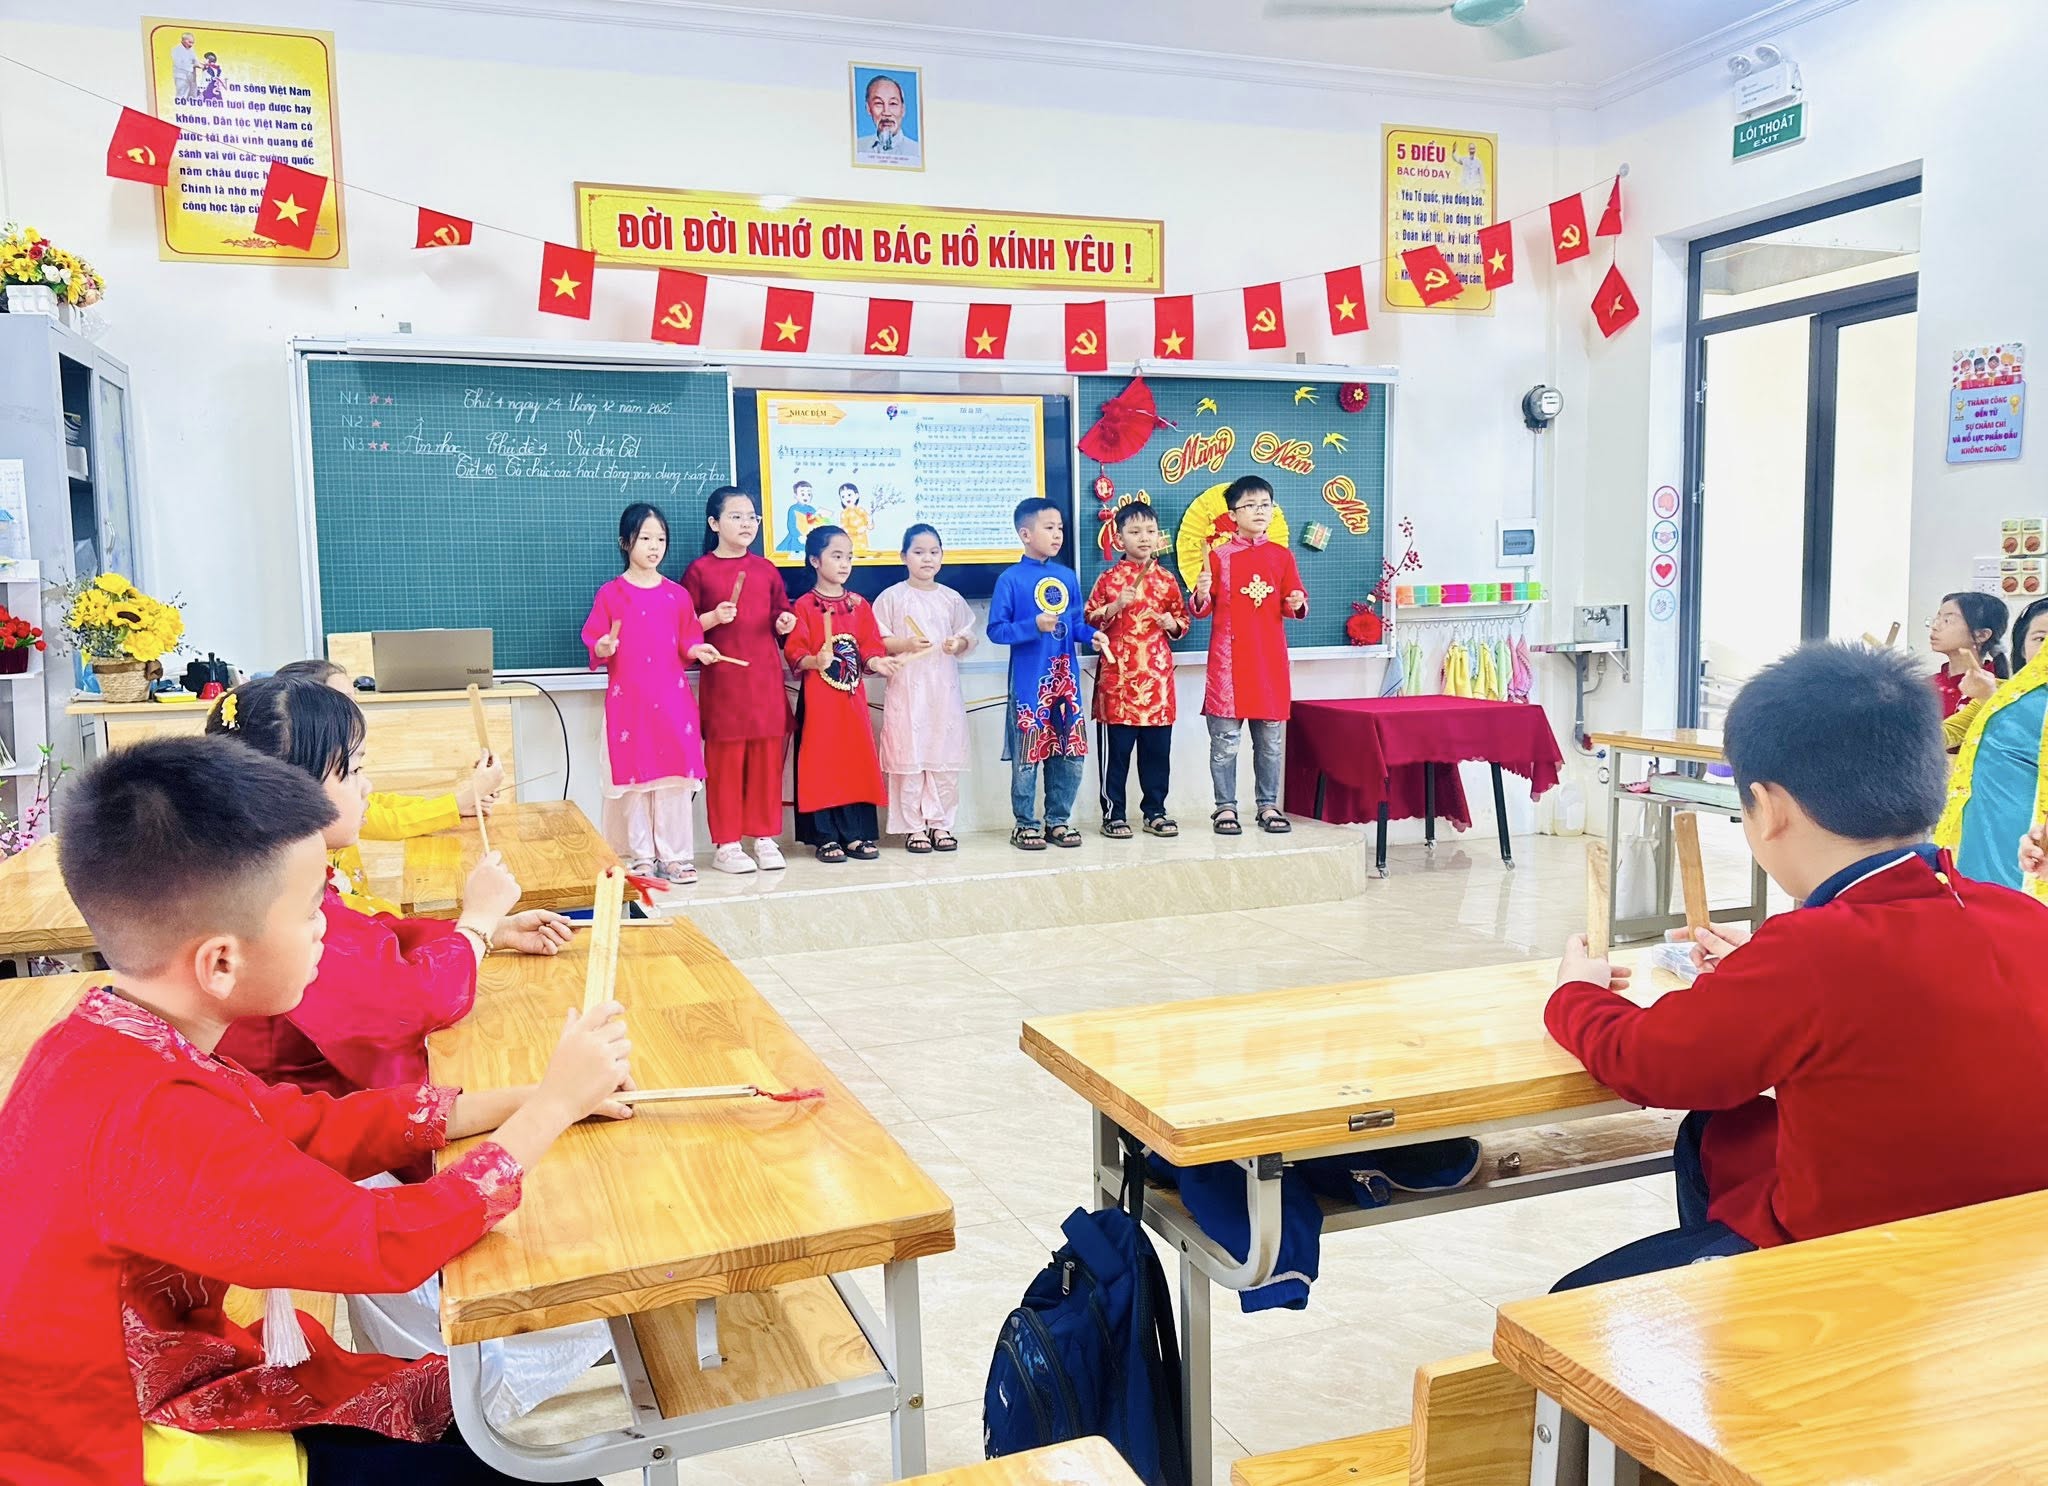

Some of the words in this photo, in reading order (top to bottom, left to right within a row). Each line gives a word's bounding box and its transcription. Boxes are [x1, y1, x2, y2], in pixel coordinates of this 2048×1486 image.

[244, 83, 266, 95] sông
[269, 85, 287, 97] Việt
[289, 87, 311, 97] Nam
[248, 101, 266, 112] đẹp
[269, 102, 292, 114] được
[294, 104, 312, 115] hay
[213, 115, 233, 126] Dân
[235, 117, 251, 128] tộc
[254, 118, 273, 130] Việt
[275, 120, 298, 130] Nam
[1758, 113, 1795, 136] THOÁT
[267, 137, 298, 148] quang
[1753, 133, 1780, 148] EXIT
[204, 151, 219, 160] vai
[291, 154, 315, 165] quốc
[1397, 143, 1406, 160] 5
[205, 168, 231, 178] châu
[215, 184, 225, 194] là
[182, 201, 207, 212] công
[209, 202, 228, 214] học
[230, 203, 246, 214] tập
[248, 203, 261, 214] củ
[1443, 212, 1453, 224] lao
[616, 207, 674, 252] ĐỜI
[683, 210, 738, 255] ĐỜI
[746, 217, 813, 260] NHỚ
[821, 221, 864, 263] ƠN
[872, 224, 932, 266] BÁC
[940, 225, 980, 269] HỒ
[988, 229, 1056, 272] KÍNH
[1063, 235, 1115, 274] YÊU
[1124, 243, 1132, 275] !
[1990, 395, 2007, 404] CÔNG
[508, 392, 541, 423] ngày
[545, 398, 564, 411] 24
[602, 400, 615, 412] 12
[619, 399, 642, 413] năm
[402, 416, 432, 454] Âm
[518, 435, 539, 454] đề
[567, 429, 590, 455] Vui
[593, 435, 615, 457] đón
[619, 433, 642, 458] Tết
[1961, 444, 1983, 454] KHÔNG
[456, 453, 481, 477] Tiết
[526, 458, 554, 478] chức
[555, 462, 572, 478] các
[655, 462, 681, 495] dụng
[684, 462, 707, 495] sáng
[1162, 427, 1234, 484] Mừng
[1252, 431, 1314, 474] Năm
[1323, 476, 1370, 534] Mới
